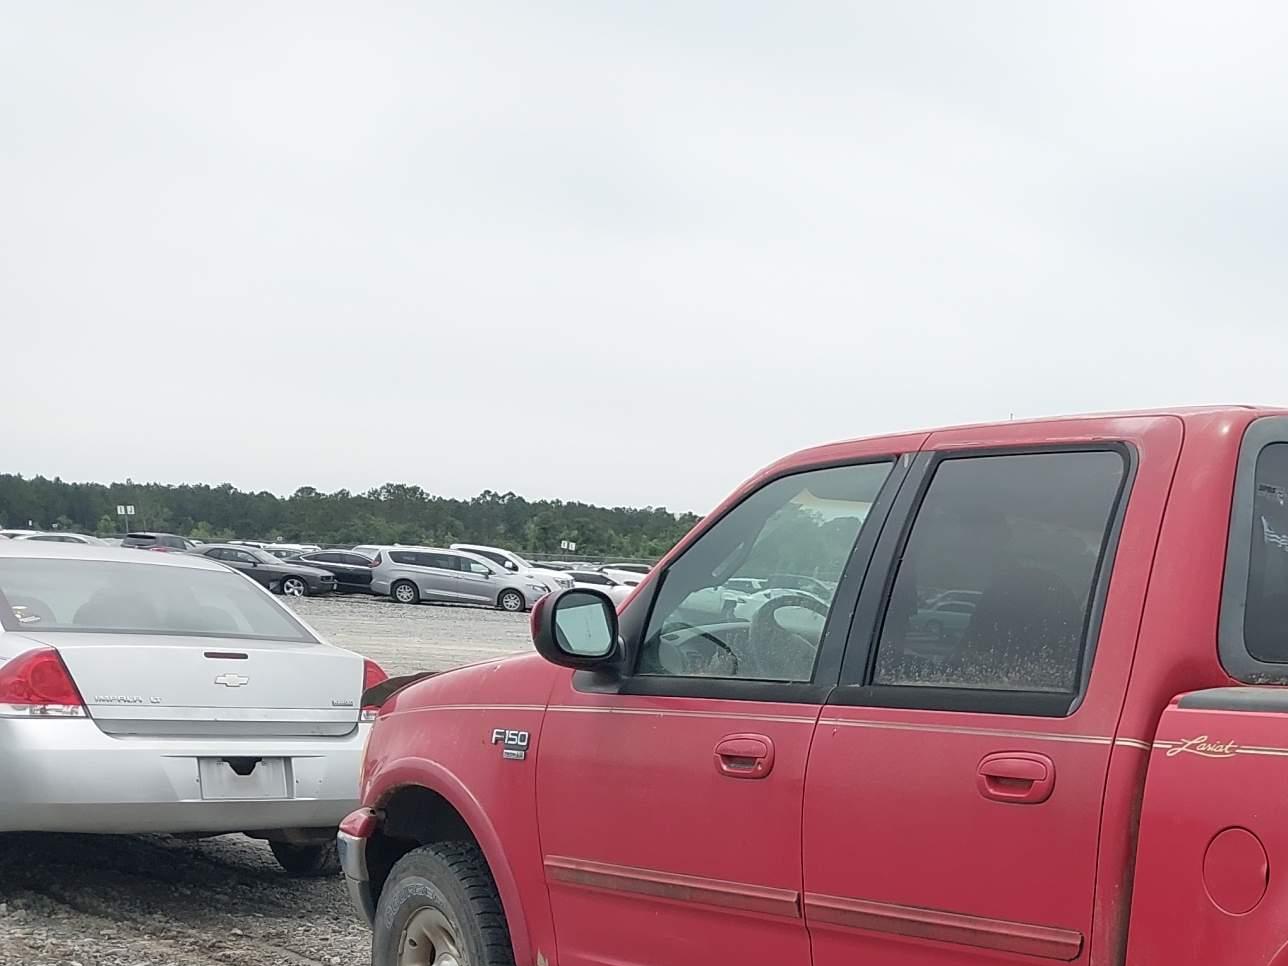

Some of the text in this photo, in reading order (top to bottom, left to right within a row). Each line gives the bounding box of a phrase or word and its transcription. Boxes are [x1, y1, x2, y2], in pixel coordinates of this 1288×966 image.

[94, 695, 143, 704] IMPALA
[491, 728, 530, 747] F150
[1166, 735, 1238, 758] Lariat
